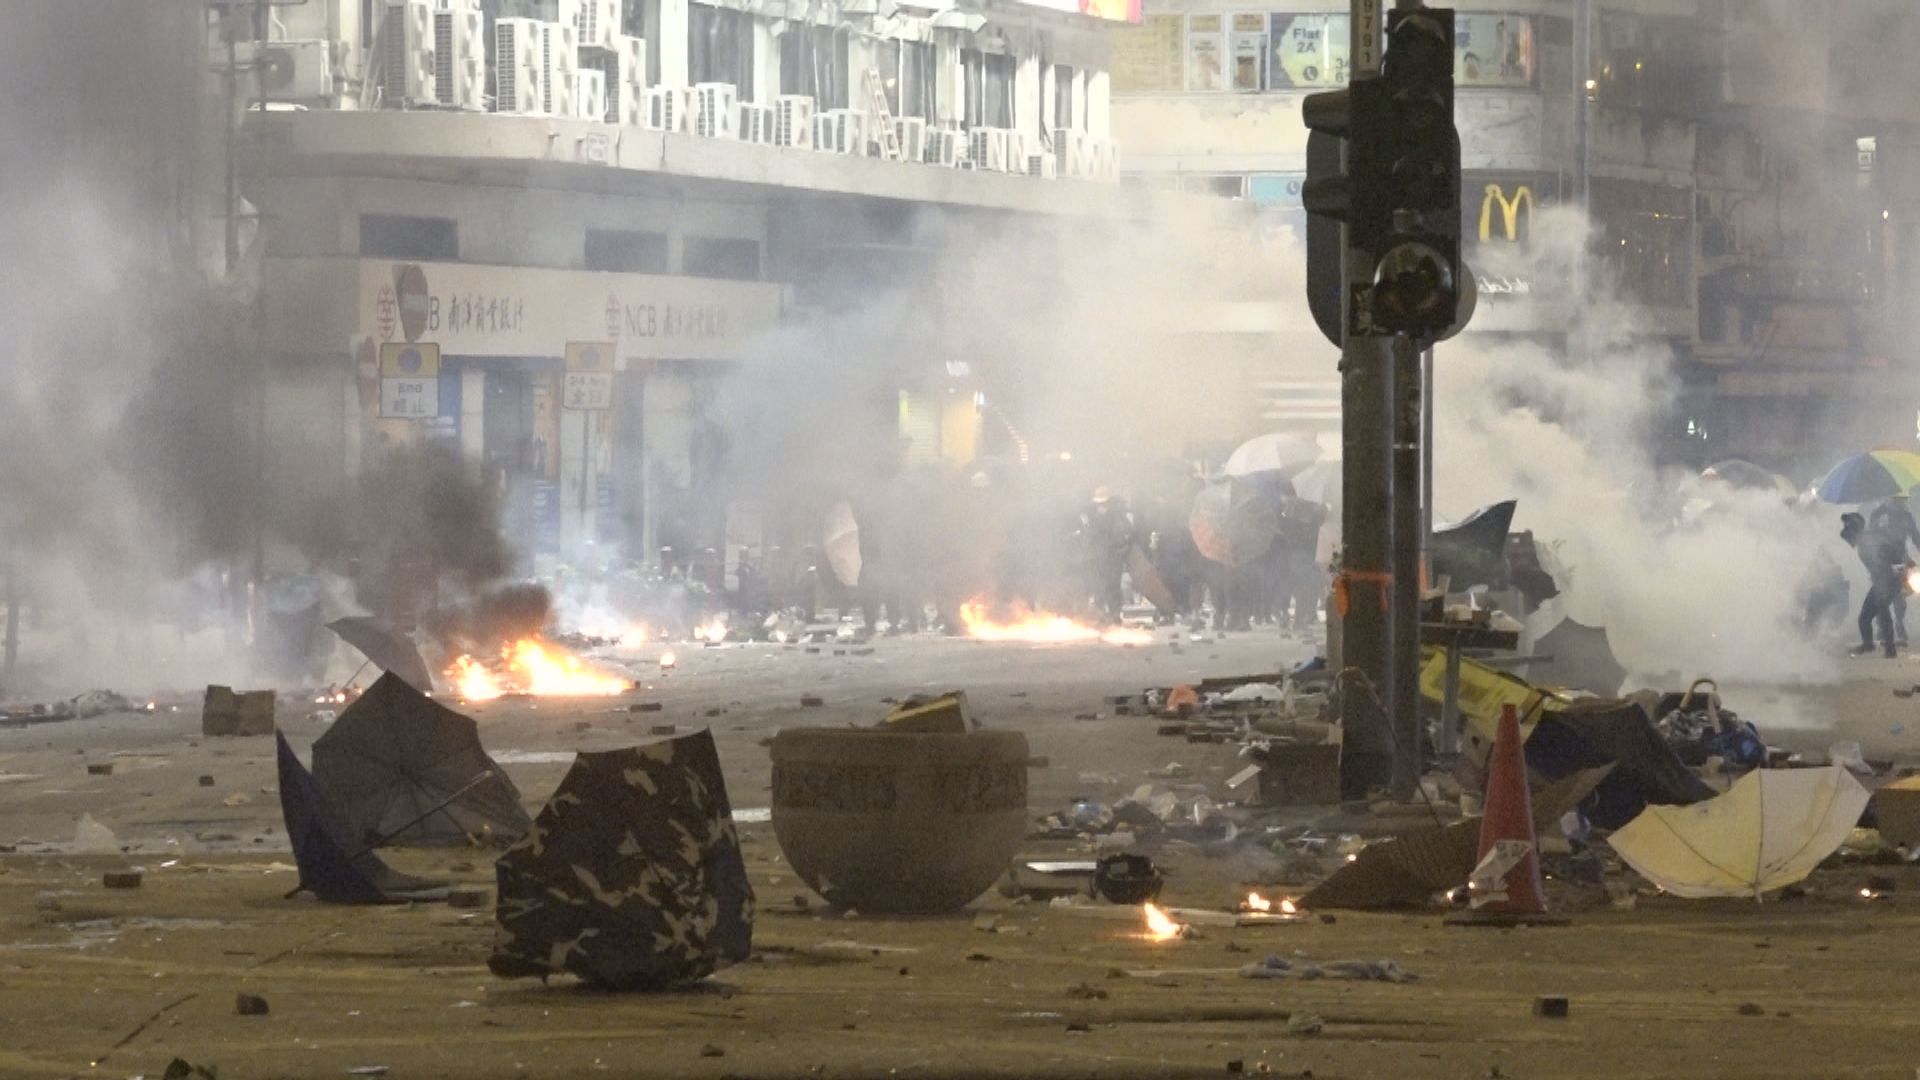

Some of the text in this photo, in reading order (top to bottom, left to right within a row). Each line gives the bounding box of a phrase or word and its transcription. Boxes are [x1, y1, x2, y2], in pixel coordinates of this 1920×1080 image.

[1293, 28, 1320, 40] Flat
[1296, 42, 1316, 54] 2A
[625, 303, 657, 337] NCB
